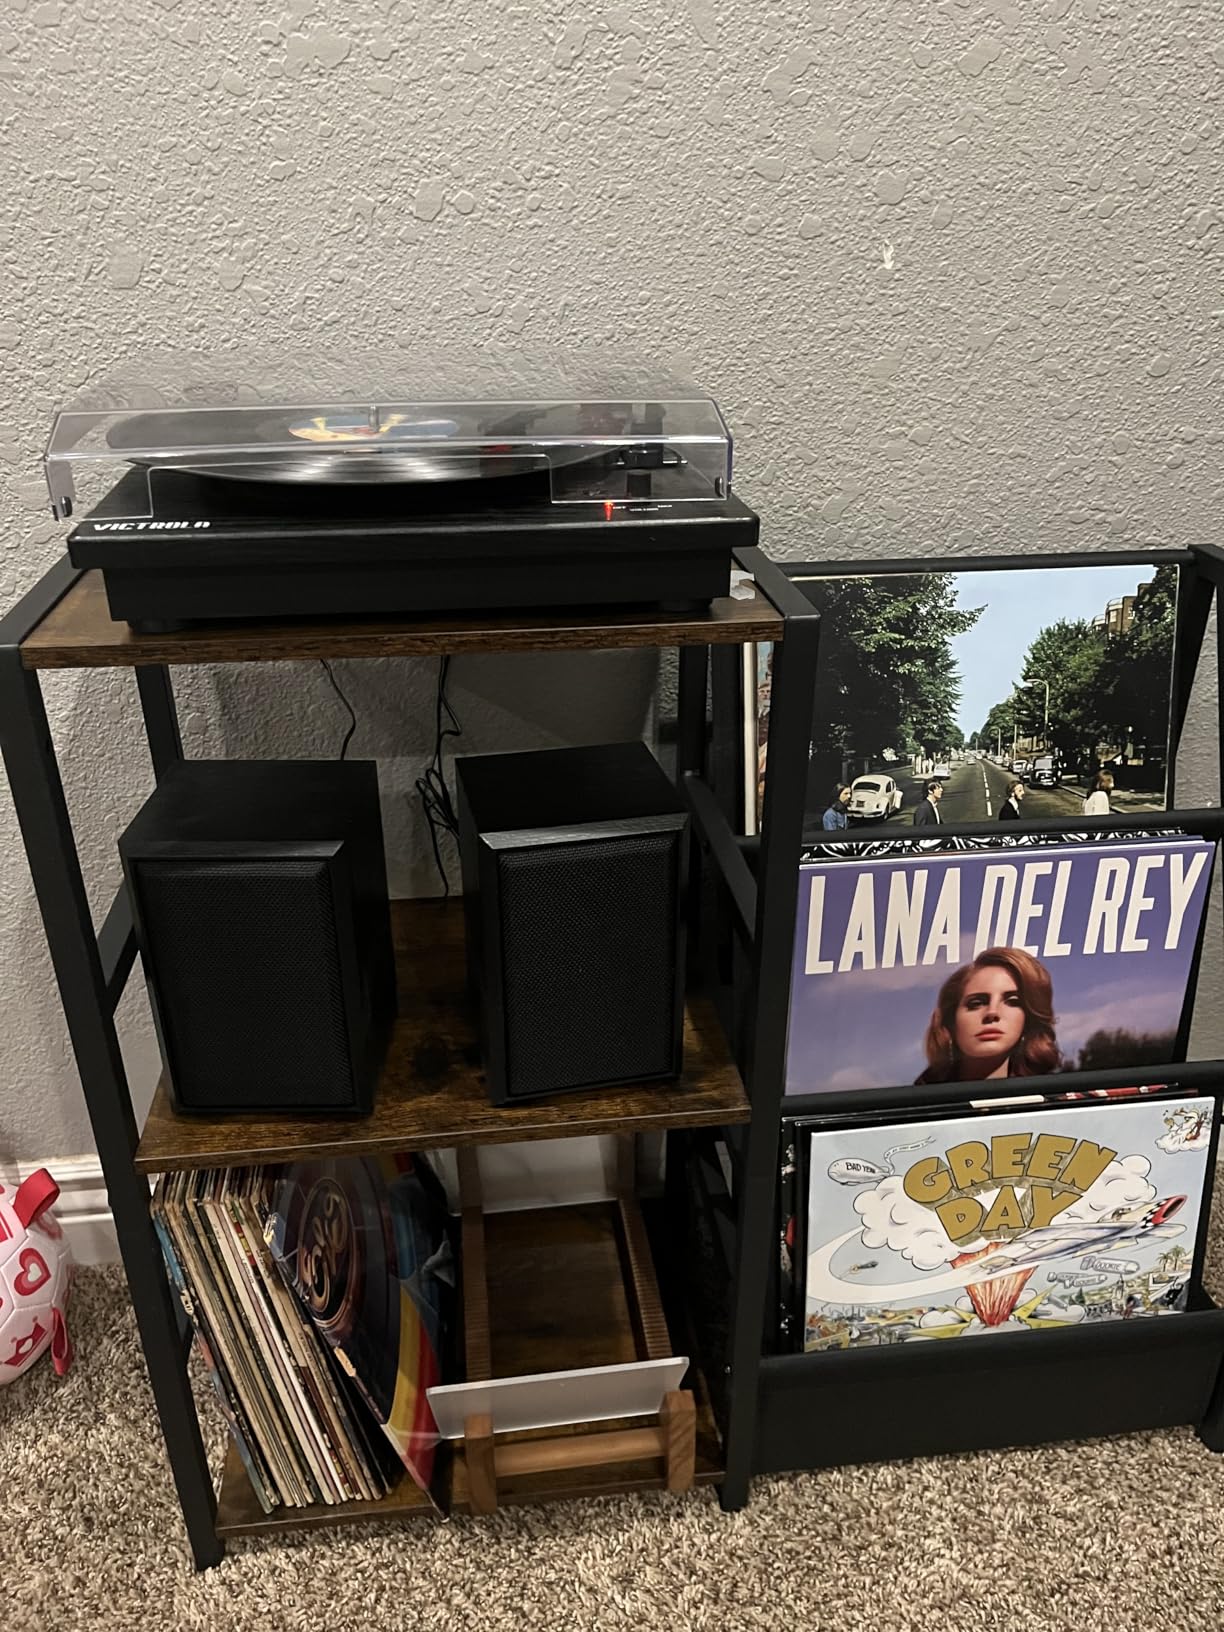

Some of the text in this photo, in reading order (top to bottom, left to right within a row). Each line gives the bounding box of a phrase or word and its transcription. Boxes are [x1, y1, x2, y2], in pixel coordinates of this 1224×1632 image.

[93, 520, 211, 531] VICTROLA
[804, 852, 1208, 975] LANA DEL REY
[845, 1161, 862, 1172] BAD
[903, 1132, 1118, 1203] GREEN
[935, 1184, 1084, 1242] DAY
